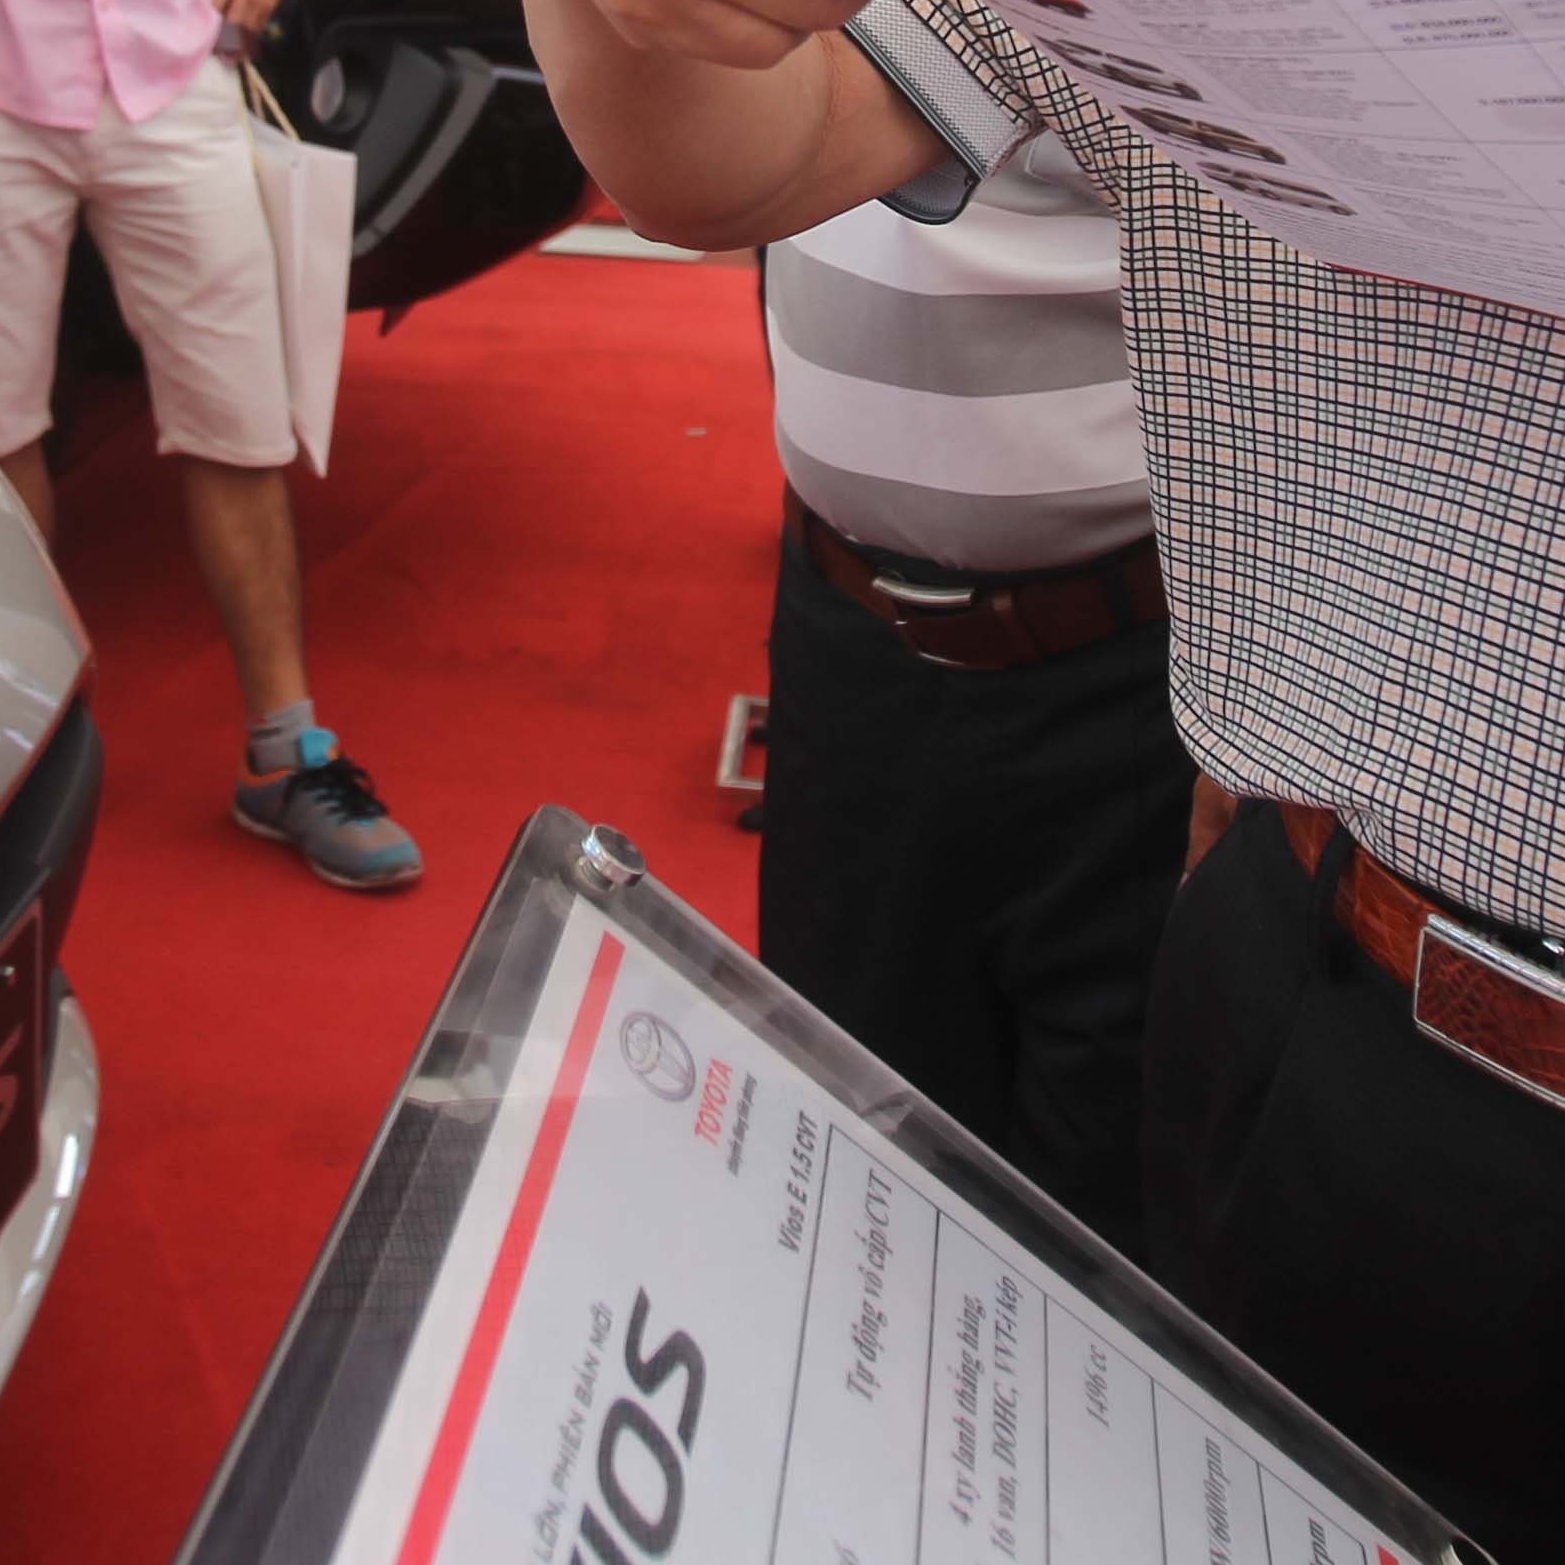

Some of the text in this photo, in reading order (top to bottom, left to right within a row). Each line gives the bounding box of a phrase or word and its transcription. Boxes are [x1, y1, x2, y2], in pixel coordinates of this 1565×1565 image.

[694, 1057, 733, 1147] TOYOTA
[778, 1110, 818, 1253] Vios E 1.5 CVT
[852, 1298, 889, 1362] động
[1085, 1343, 1110, 1429] 1496 cc
[951, 1415, 977, 1474] lanh
[992, 1381, 1021, 1470] DOHC,
[948, 1499, 971, 1527] 4
[956, 1471, 981, 1506] xy
[989, 1522, 1017, 1560] 16
